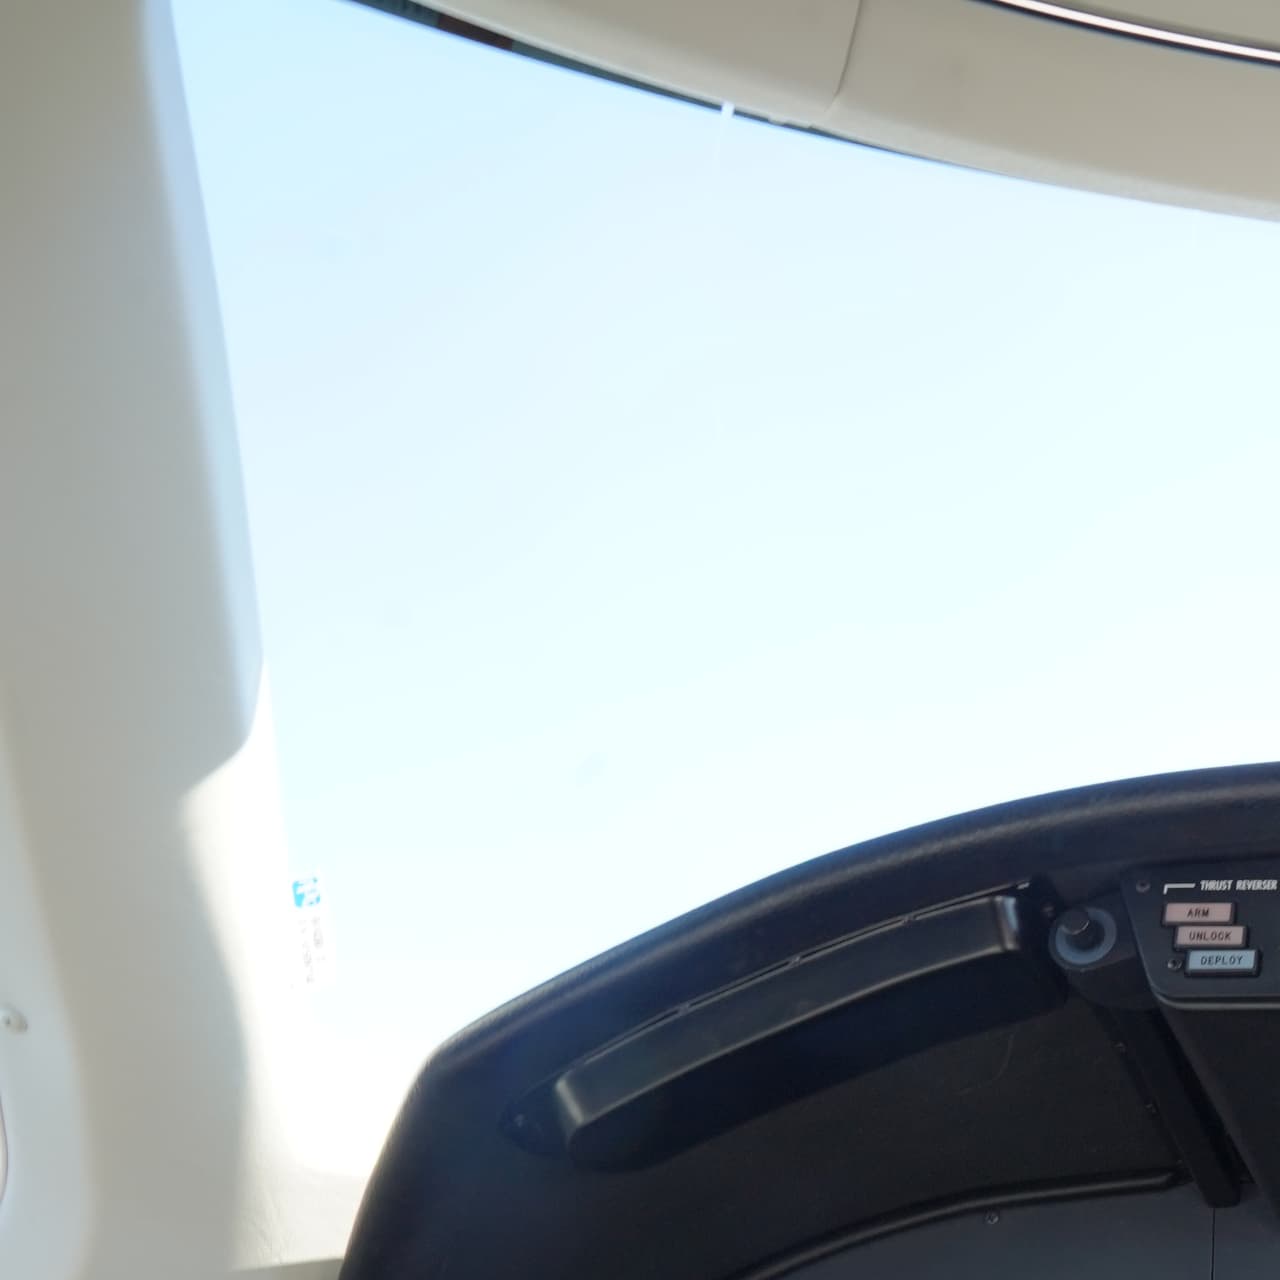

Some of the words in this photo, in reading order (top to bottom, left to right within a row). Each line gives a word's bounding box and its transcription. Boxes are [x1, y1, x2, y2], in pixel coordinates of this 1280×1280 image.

[1201, 880, 1233, 890] THRUST
[1236, 880, 1277, 890] REVERSER
[1187, 908, 1209, 917] ARM
[1189, 931, 1231, 941] UNLOCK
[1200, 956, 1243, 965] DEPLOY
